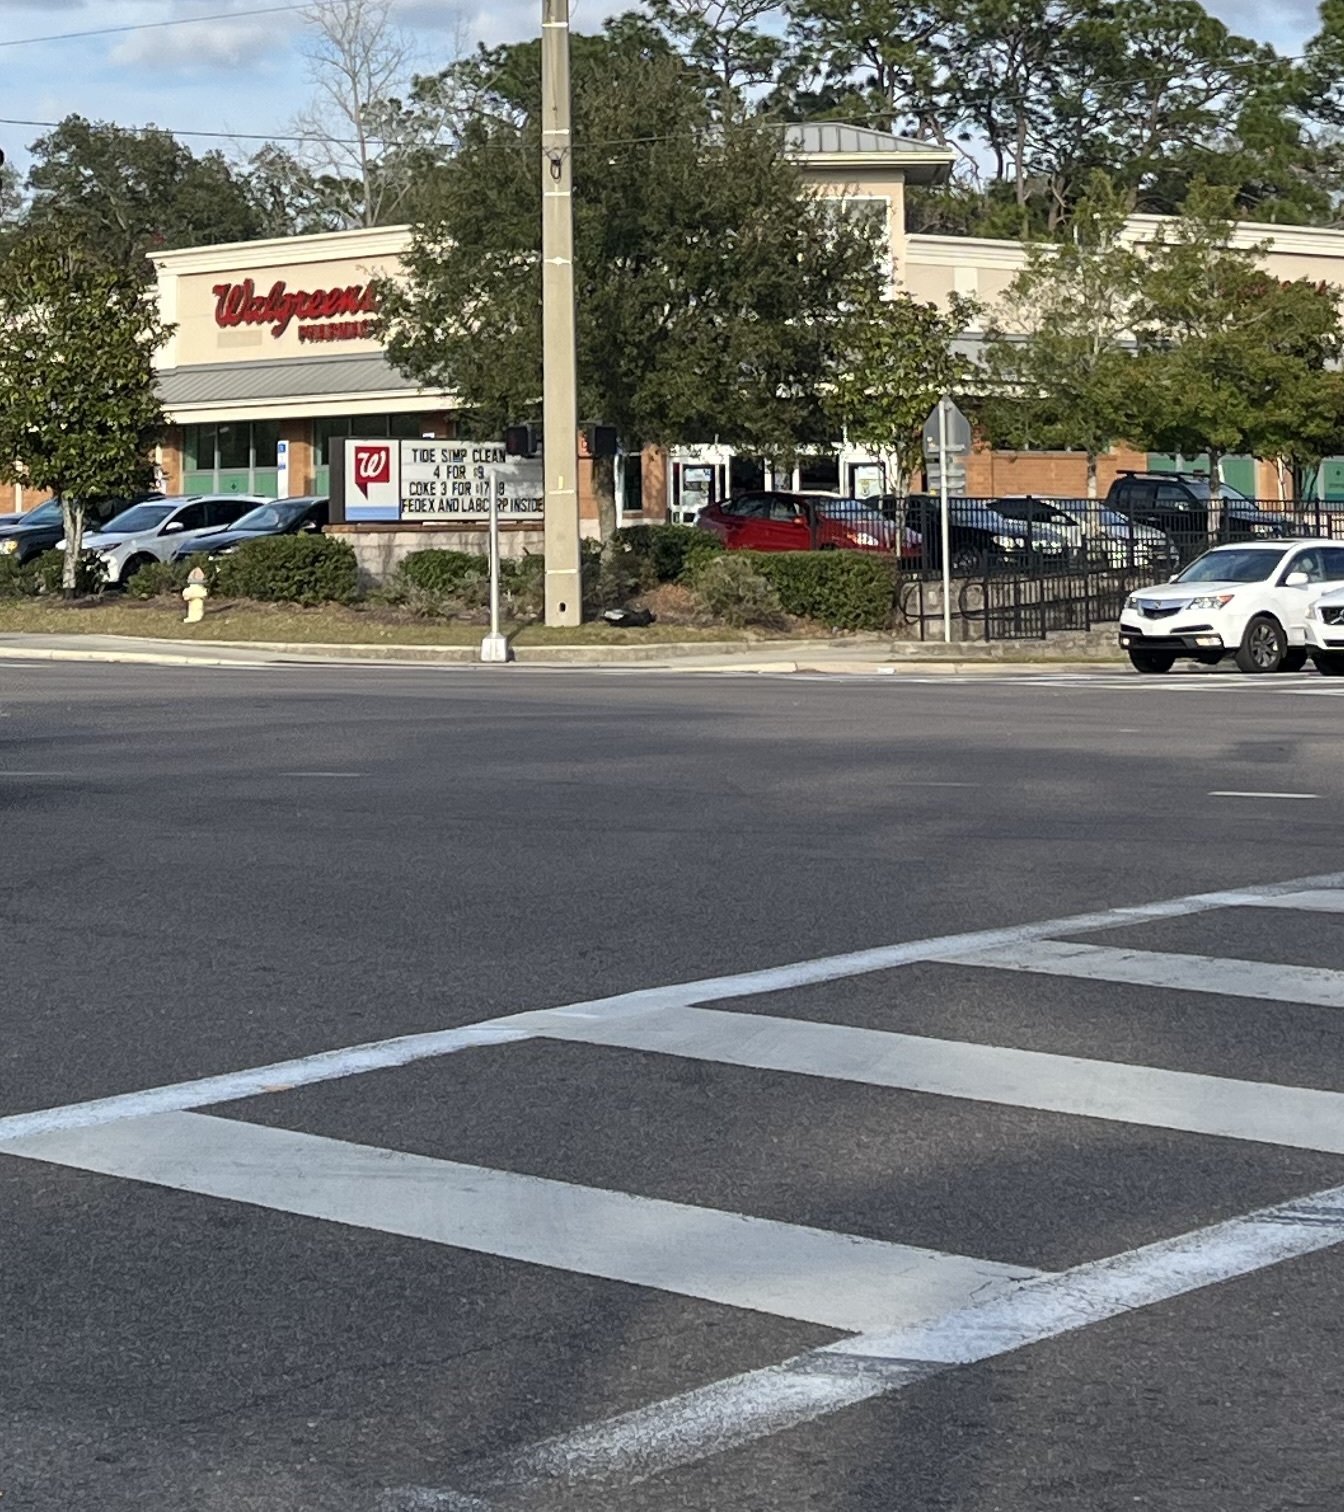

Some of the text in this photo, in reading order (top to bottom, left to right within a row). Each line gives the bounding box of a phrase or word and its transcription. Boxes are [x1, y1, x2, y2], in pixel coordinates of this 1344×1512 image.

[212, 277, 384, 339] Walgreens
[412, 448, 506, 463] TIDE SIMP CLEAN
[433, 465, 440, 479] 4
[446, 465, 466, 479] FOR
[409, 481, 436, 496] COKE
[440, 481, 447, 495] 3
[452, 481, 472, 495] FOR
[401, 497, 544, 513] FEDEX AND LABCRP INSIDE
